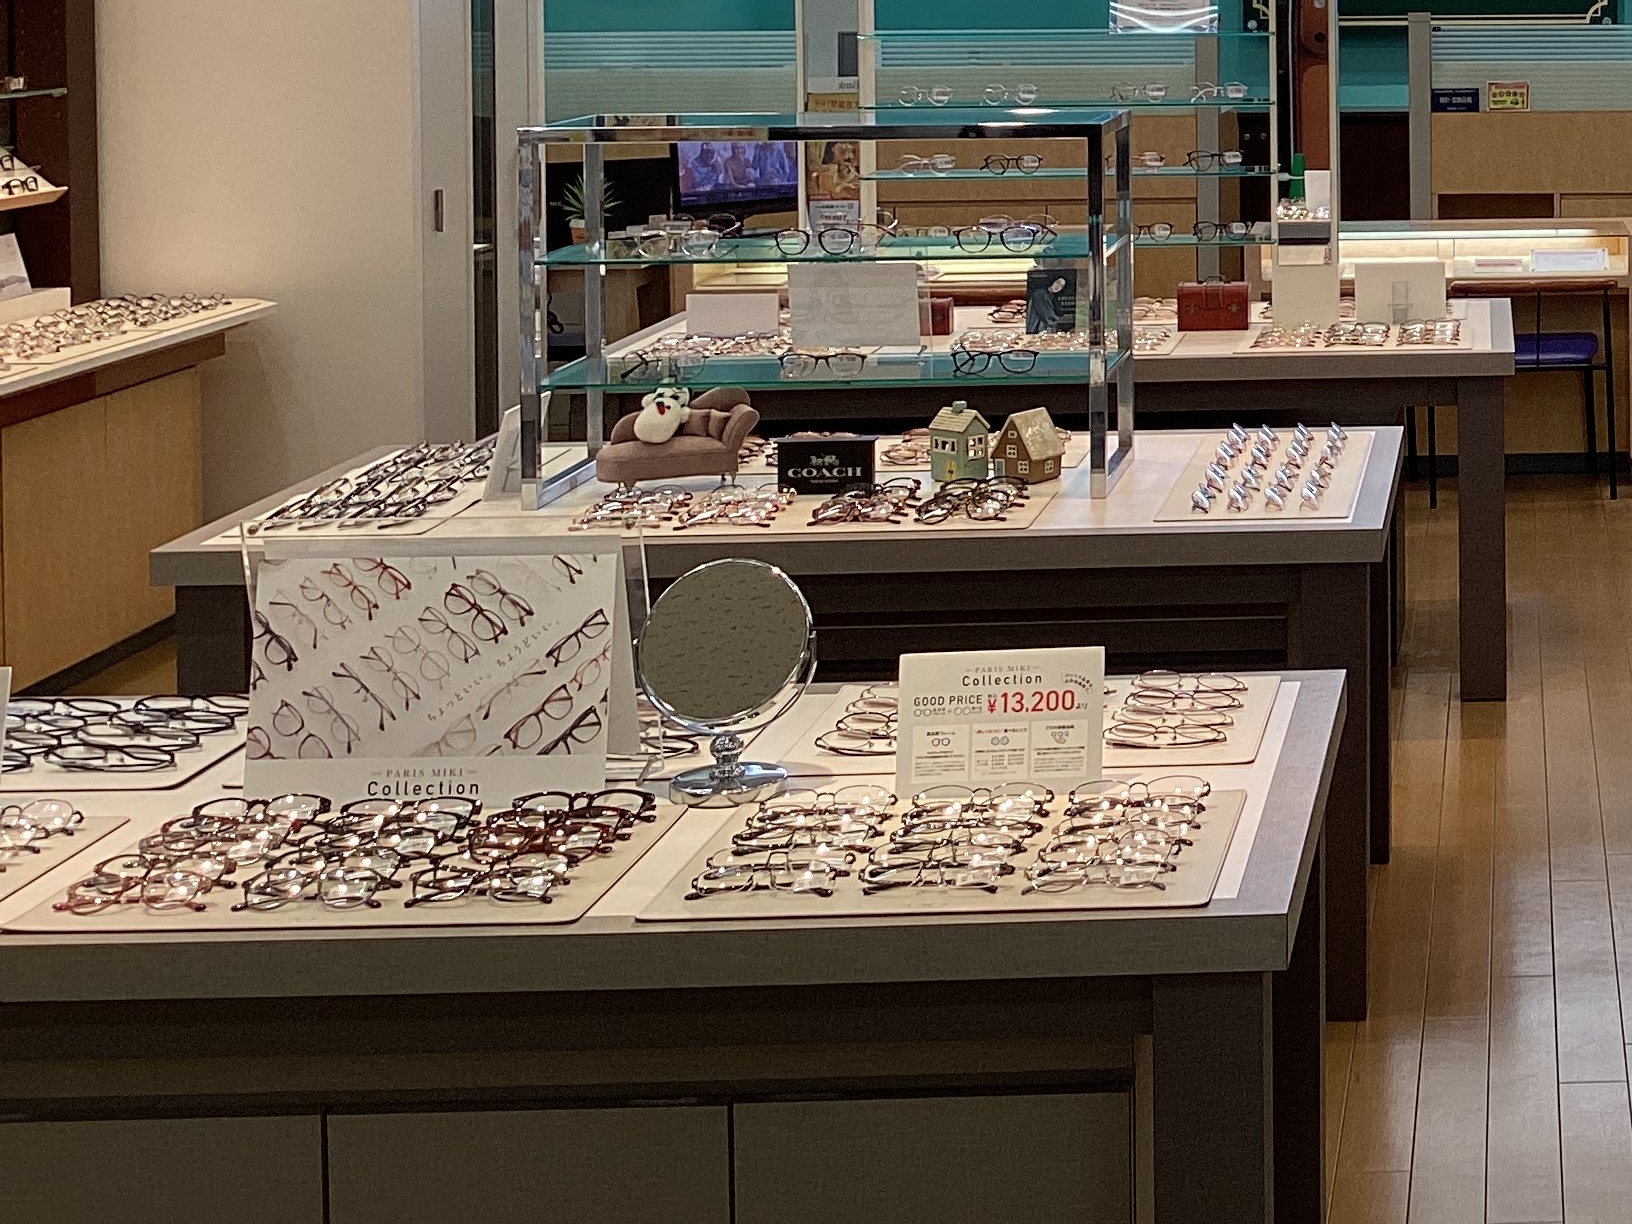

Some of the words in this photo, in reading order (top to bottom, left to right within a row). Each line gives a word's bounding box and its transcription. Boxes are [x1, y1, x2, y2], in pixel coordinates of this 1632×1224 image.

[787, 466, 863, 478] COACH
[975, 665, 1003, 674] PARIS
[1007, 664, 1032, 673] MIKI
[962, 674, 1043, 687] Collection
[913, 696, 945, 707] GOOD
[949, 694, 983, 705] PRICE
[386, 769, 425, 778] PARIS
[432, 768, 464, 777] MIKI
[367, 779, 480, 796] Collection
